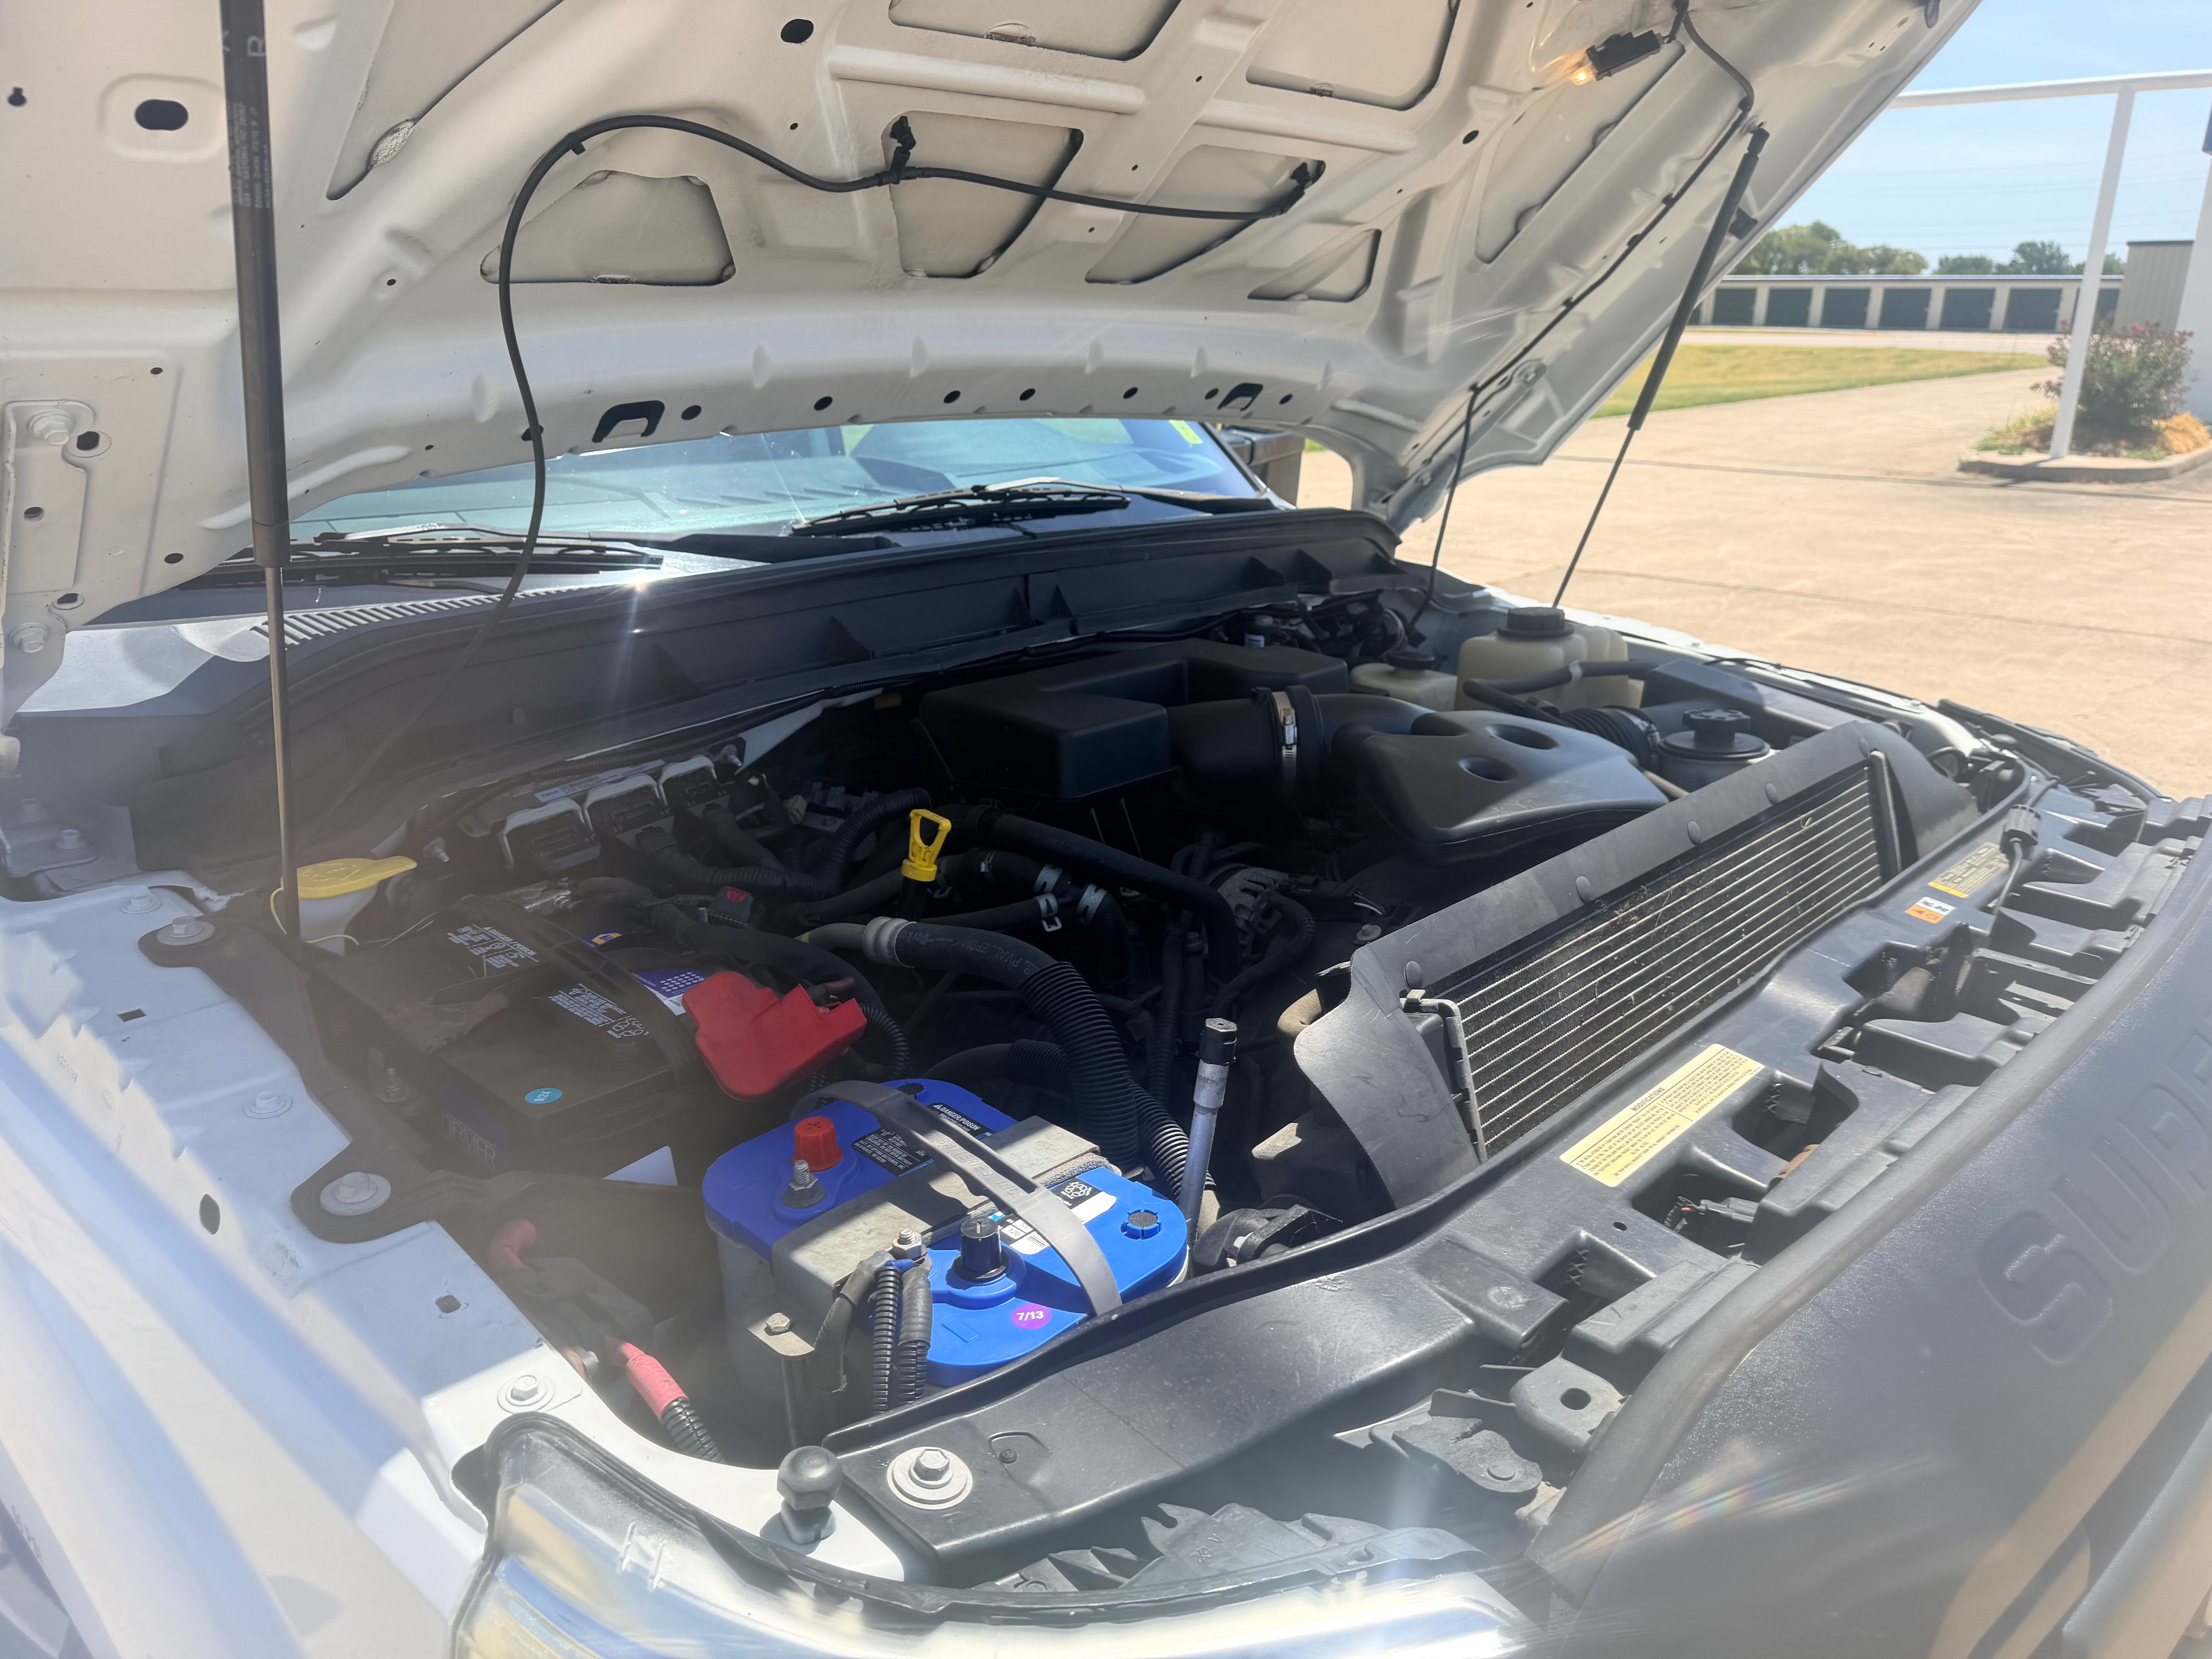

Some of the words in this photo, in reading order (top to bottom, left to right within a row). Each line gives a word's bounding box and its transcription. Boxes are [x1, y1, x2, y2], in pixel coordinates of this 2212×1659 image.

[533, 1091, 552, 1102] 9/24
[1630, 1087, 1665, 1112] MODIFICATIONS
[995, 1179, 1022, 1199] INC.
[1017, 1310, 1044, 1321] 7/13
